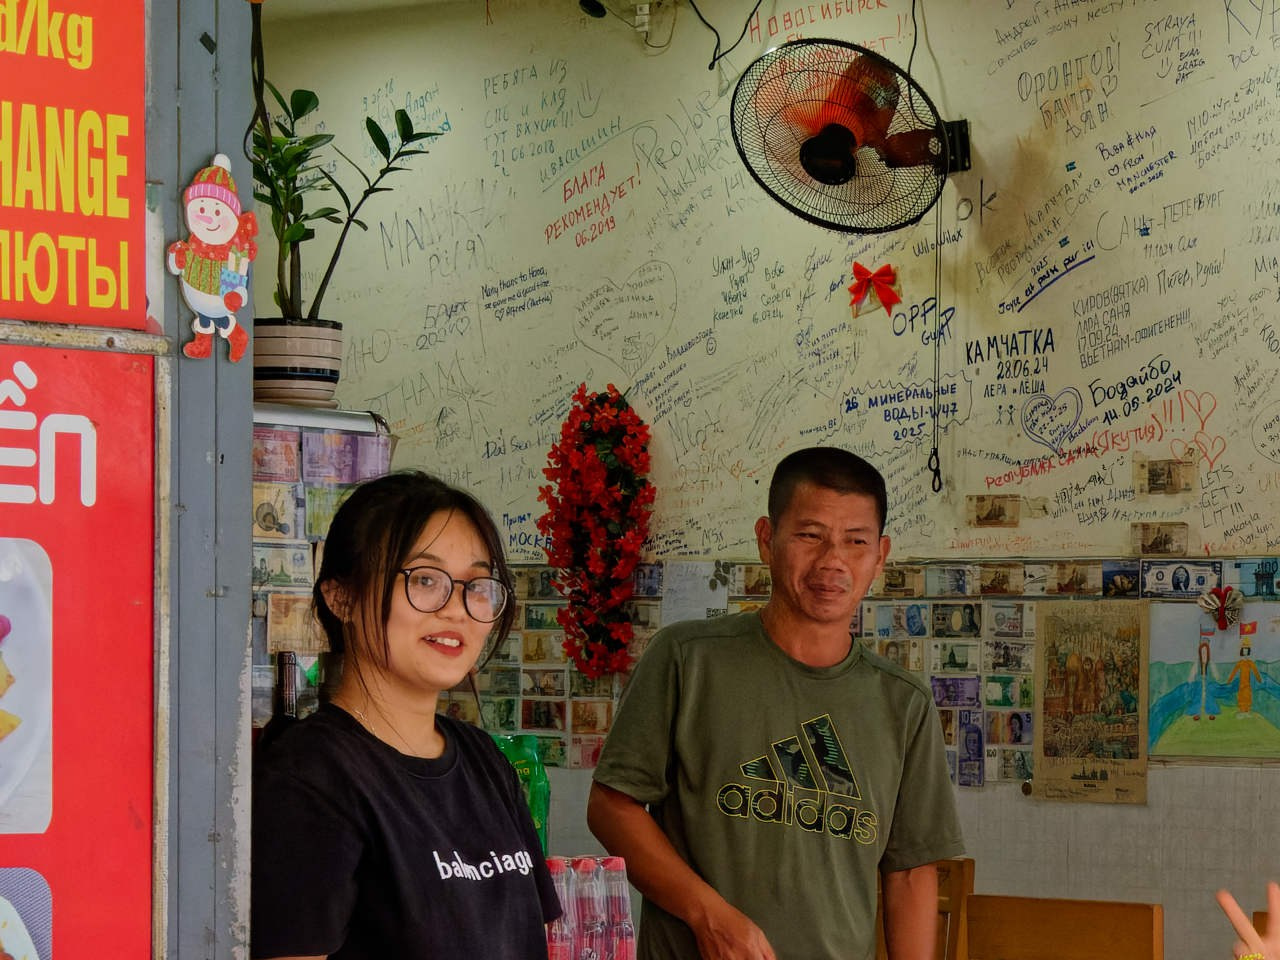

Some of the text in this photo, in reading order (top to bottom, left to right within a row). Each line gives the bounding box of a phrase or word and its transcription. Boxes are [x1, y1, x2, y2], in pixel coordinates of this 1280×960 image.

[965, 327, 1055, 366] КАМЧАТКА
[996, 356, 1049, 380] 28.06.24
[1087, 353, 1172, 408] Бодайбо
[893, 422, 927, 441] 2025
[1200, 463, 1234, 490] LET'S
[1200, 485, 1231, 509] GET
[716, 779, 878, 845] adidas
